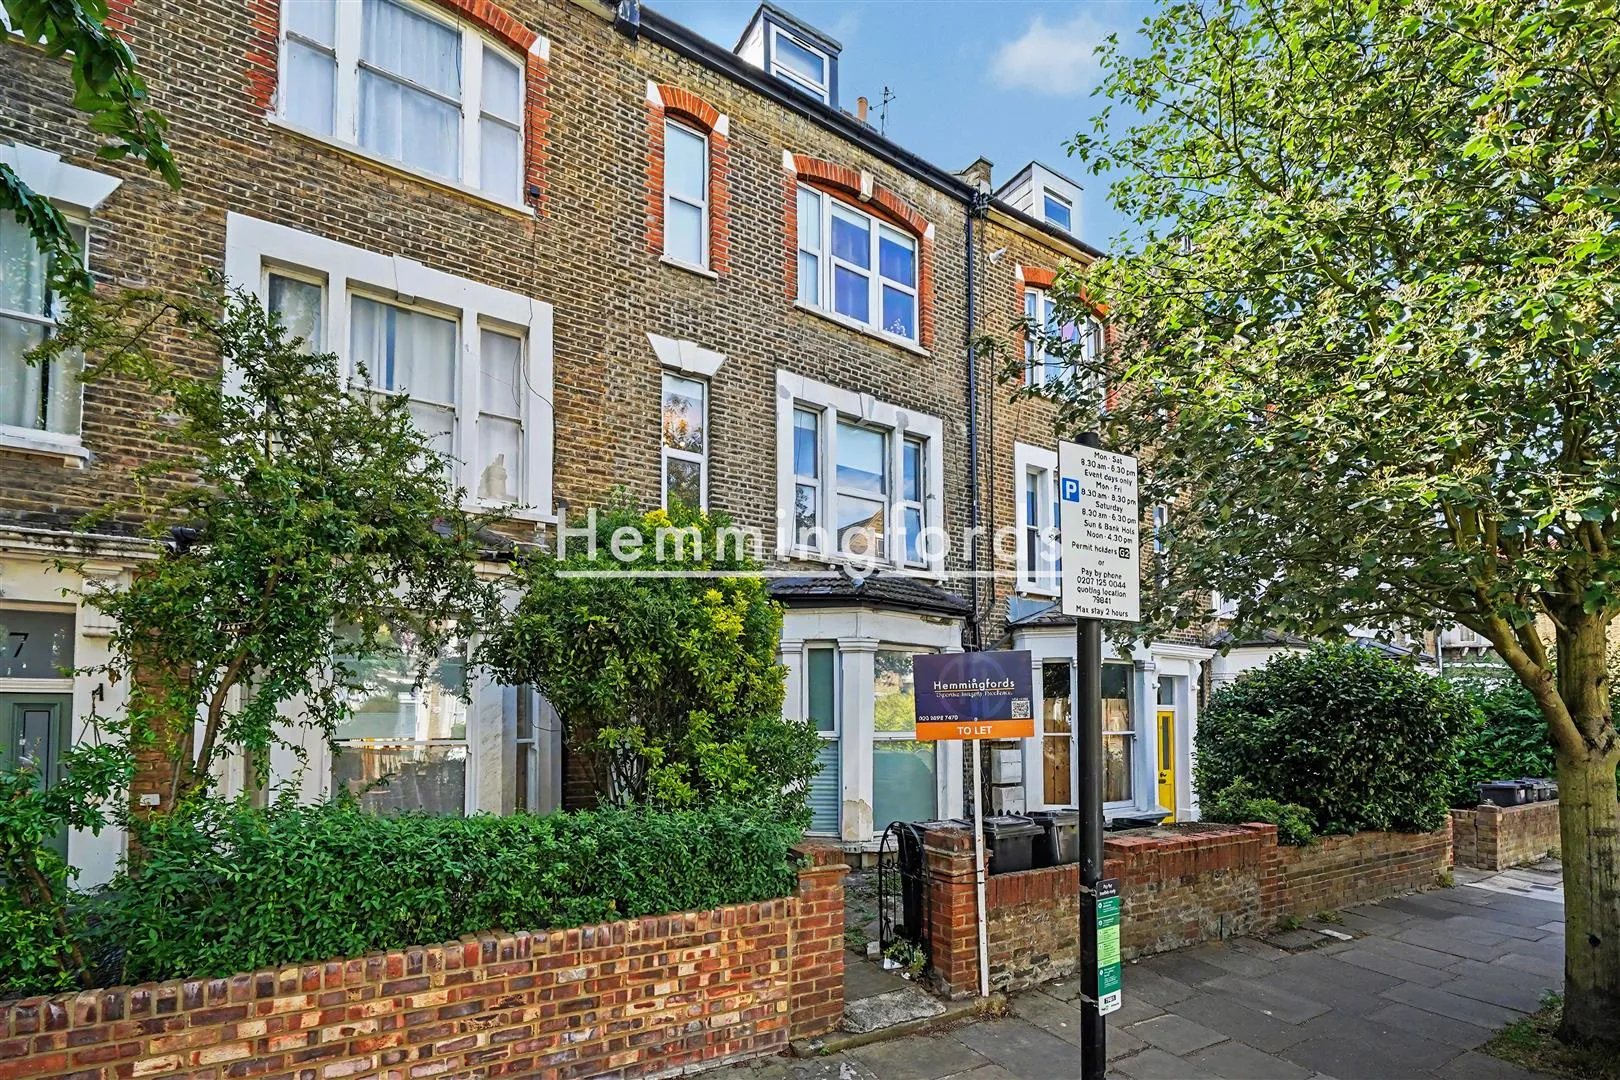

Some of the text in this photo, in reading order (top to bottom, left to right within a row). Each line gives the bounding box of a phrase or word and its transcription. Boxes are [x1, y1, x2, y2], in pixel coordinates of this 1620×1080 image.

[1094, 452, 1107, 460] Mon
[1112, 456, 1122, 464] Sat
[1080, 458, 1096, 468] 8.30
[1111, 465, 1125, 475] 6.30
[1084, 469, 1133, 486] Event days only
[1066, 480, 1077, 499] P
[1081, 488, 1096, 497] 8.30
[1096, 481, 1109, 490] Mon
[1114, 485, 1122, 493] Fri
[1096, 501, 1123, 513] Saturday
[1082, 508, 1097, 517] 8.30
[1112, 514, 1126, 523] 6.30
[1084, 520, 1096, 528] Sun
[1104, 523, 1120, 532] Bank
[1122, 526, 1135, 535] Hols
[1087, 530, 1103, 539] Noon
[1108, 534, 1122, 542] 4.30
[1072, 541, 1130, 557] Permit holders G2
[1081, 568, 1122, 580] Pay by phone
[1077, 576, 1126, 589] 0207 125 0044
[1077, 586, 1126, 598] quoting location
[1076, 605, 1089, 613] Max
[1091, 608, 1104, 616] stay
[1112, 609, 1128, 617] hours
[934, 678, 1015, 691] Hemmingfords
[957, 726, 992, 735] TO LET
